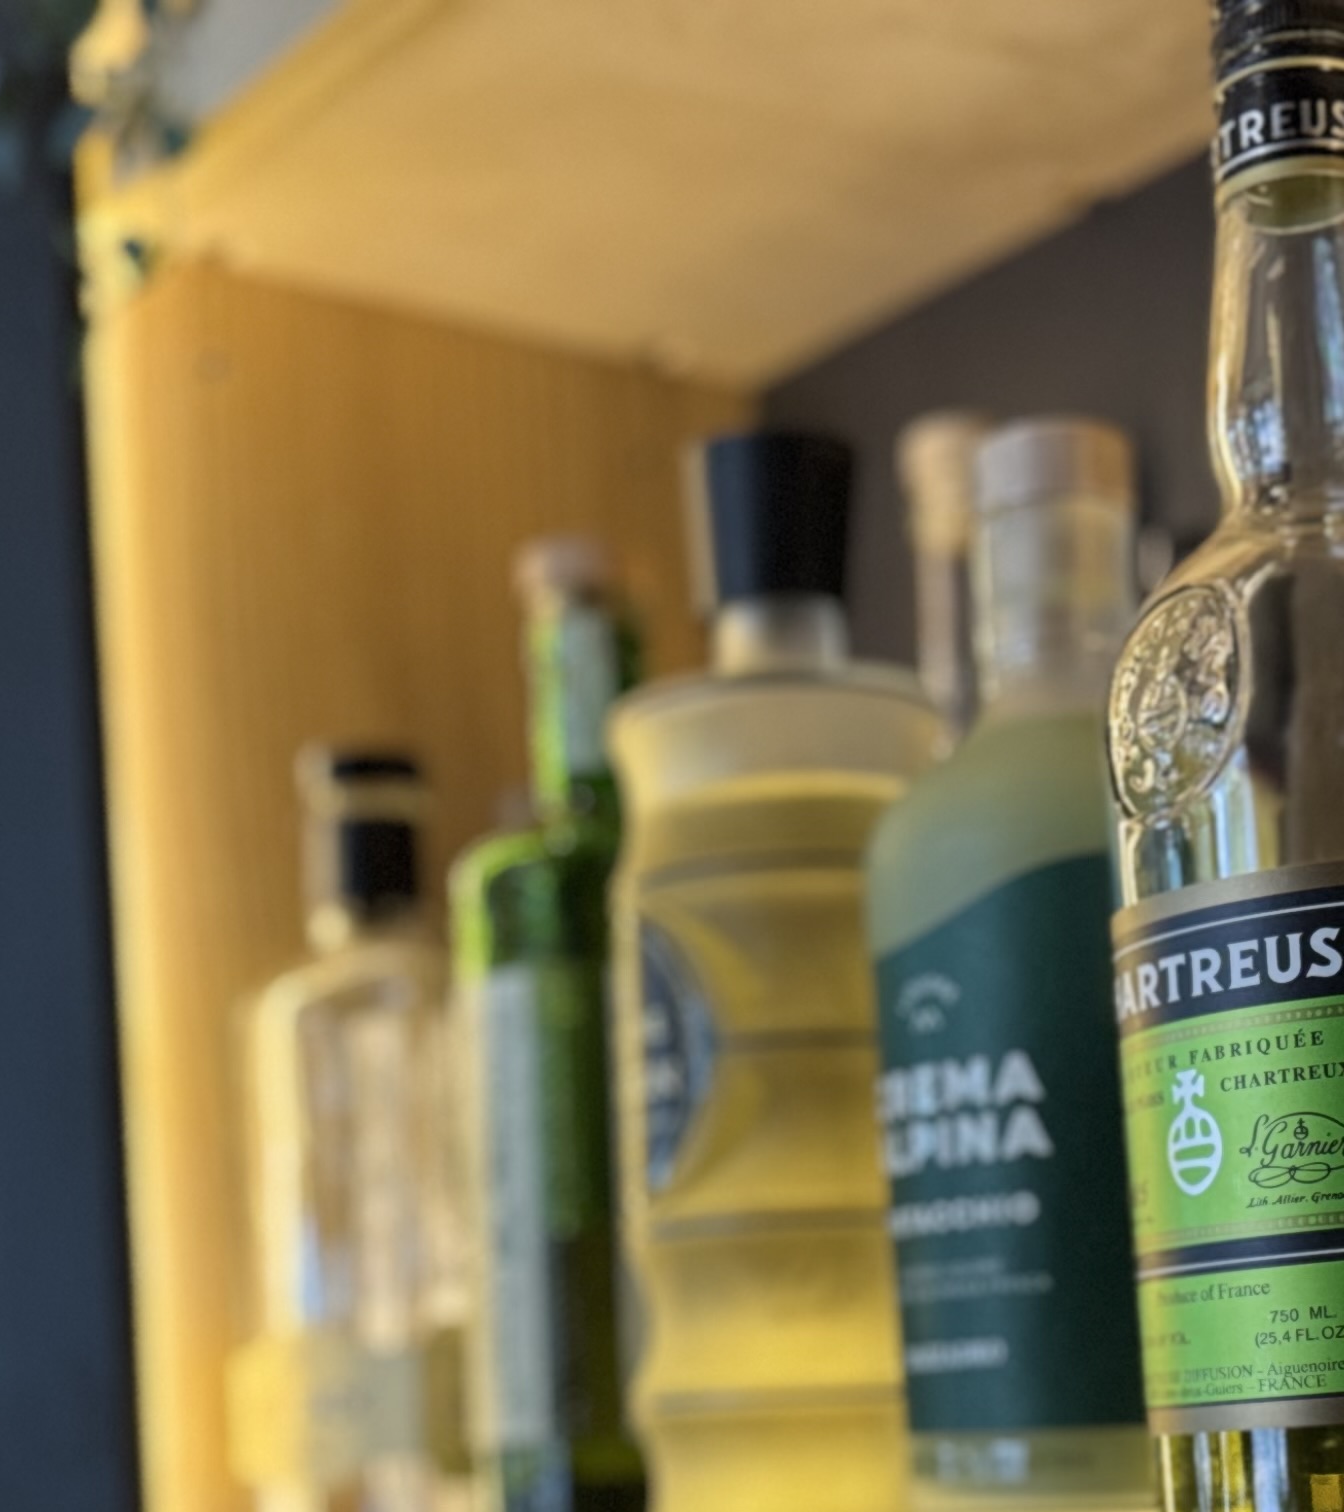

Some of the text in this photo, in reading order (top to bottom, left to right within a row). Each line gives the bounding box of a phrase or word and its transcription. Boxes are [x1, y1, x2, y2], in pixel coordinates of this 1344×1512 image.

[1188, 1029, 1326, 1066] FABRIQUÉE
[884, 1104, 1055, 1176] LPINA
[1200, 1283, 1216, 1302] of
[1217, 1280, 1271, 1299] France
[1269, 1304, 1338, 1323] 750 ML.
[1254, 1329, 1292, 1350] (25,4
[1258, 1373, 1328, 1393] FRANCE
